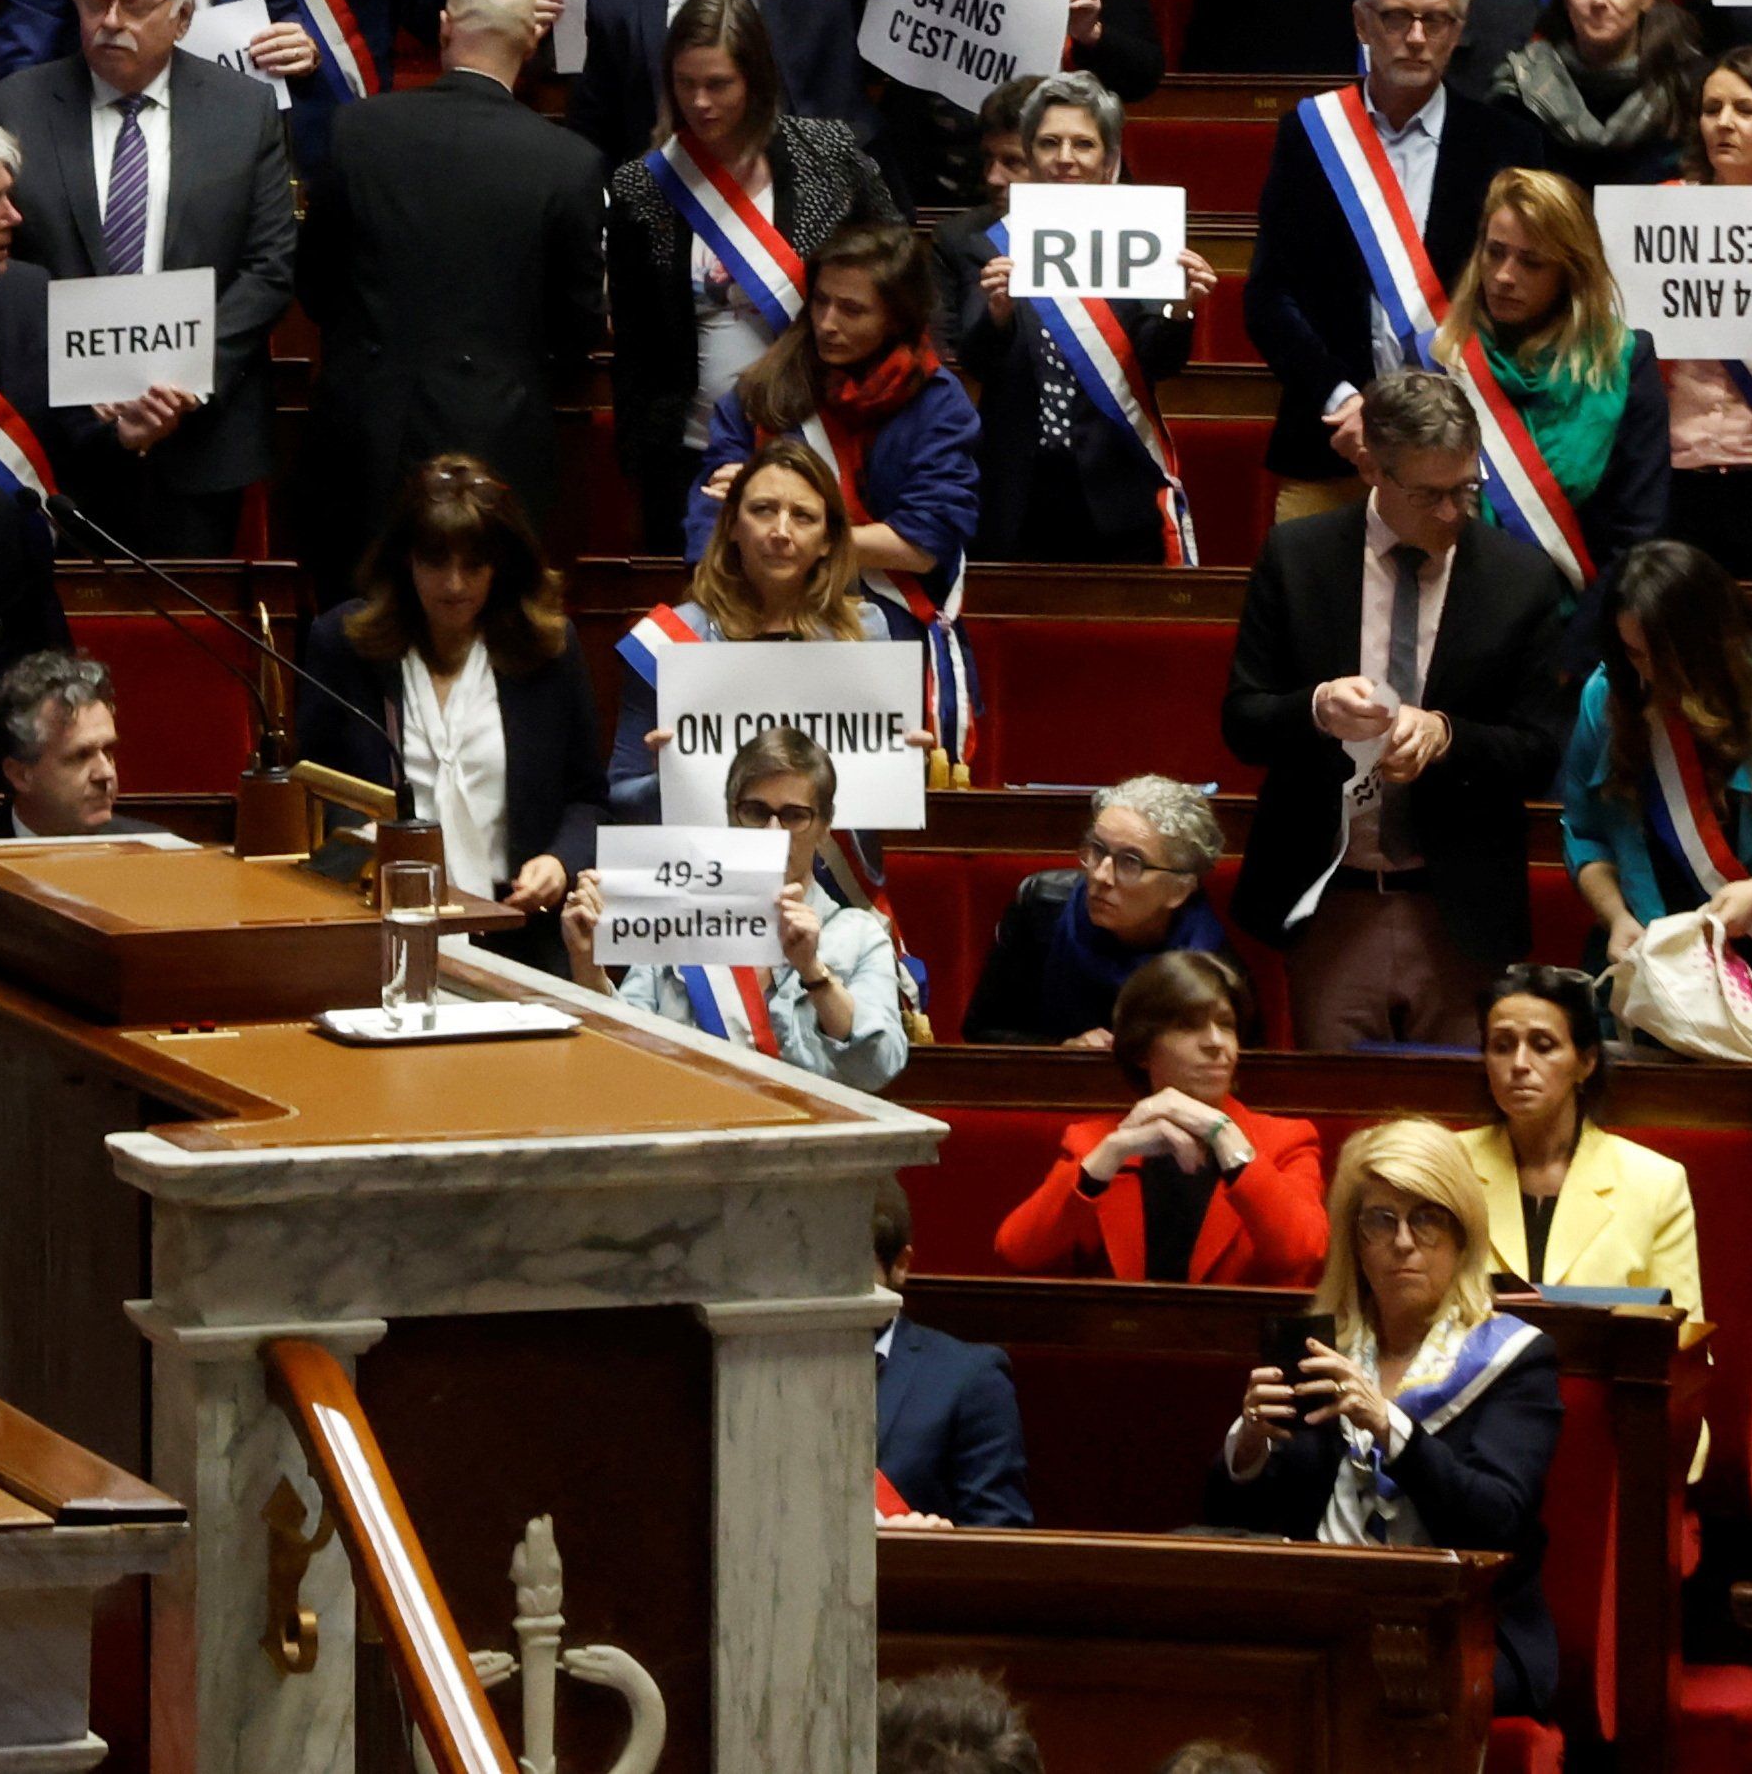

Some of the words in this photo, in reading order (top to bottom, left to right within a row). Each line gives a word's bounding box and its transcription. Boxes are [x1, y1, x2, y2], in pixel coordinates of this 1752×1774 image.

[890, 10, 958, 61] C'EST
[957, 40, 1017, 85] NON
[1033, 230, 1161, 288] RIP
[1635, 225, 1698, 264] NON
[1663, 279, 1724, 318] ANS
[66, 320, 200, 358] RETRAIT
[677, 714, 721, 754] ON
[655, 861, 723, 887] 49-3
[613, 909, 766, 945] populaire
